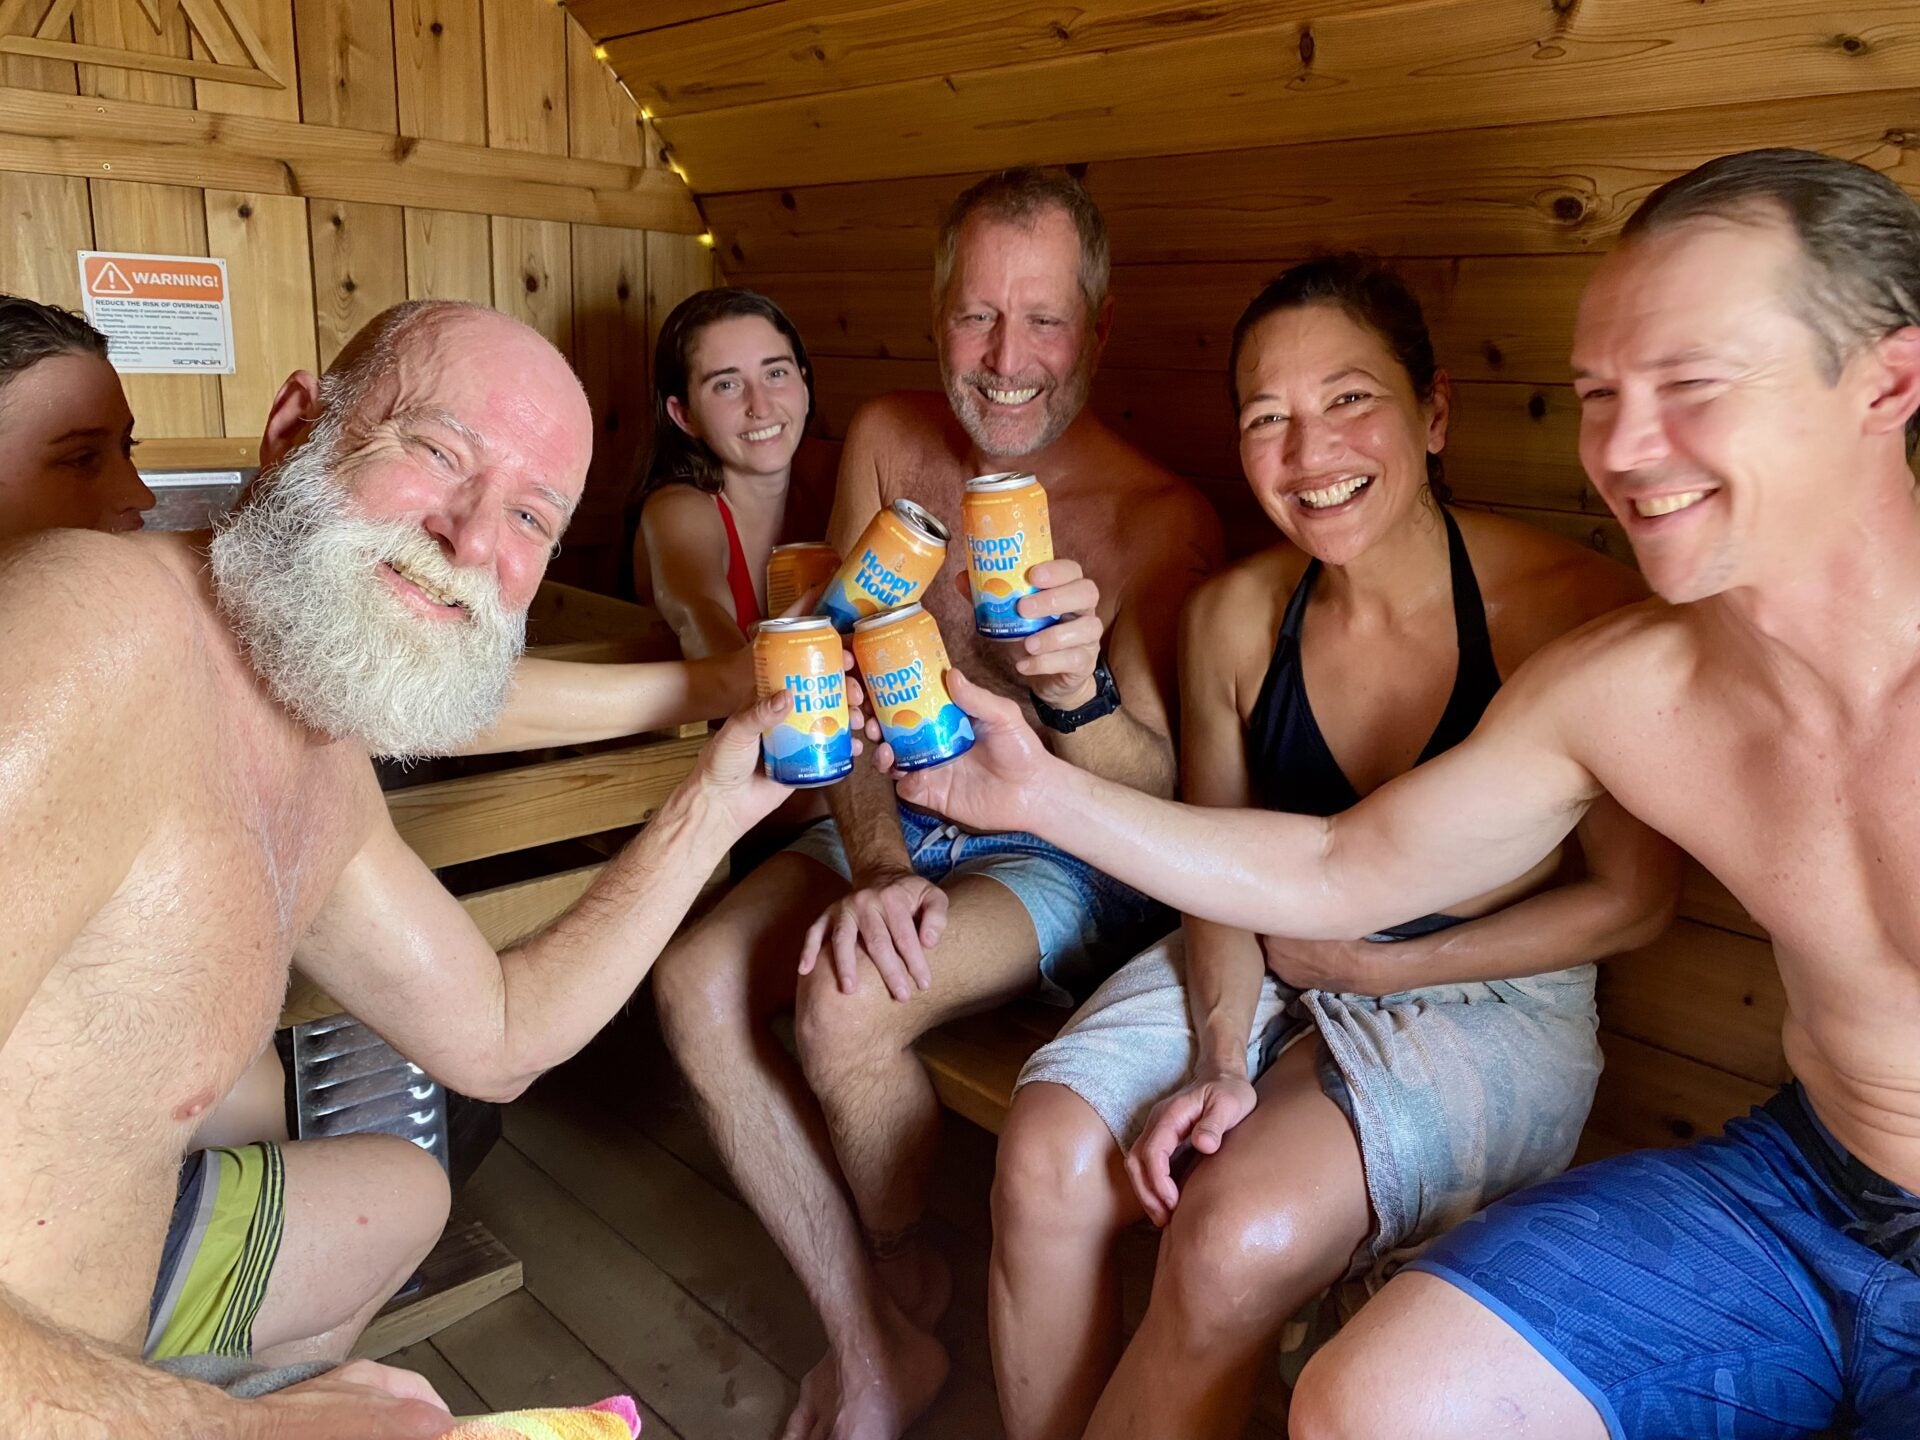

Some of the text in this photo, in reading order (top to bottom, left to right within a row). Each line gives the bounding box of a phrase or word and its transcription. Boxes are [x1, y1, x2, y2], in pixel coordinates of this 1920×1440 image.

[131, 271, 219, 288] WARNING!
[172, 302, 220, 310] OVERHEATING
[966, 531, 1024, 554] Hoppy
[860, 548, 918, 595] Hoppy
[973, 554, 1019, 572] Hour
[854, 568, 902, 608] Hour
[784, 668, 844, 693] Hoppy
[865, 659, 923, 688] Hoppy
[795, 692, 842, 713] Hour
[875, 684, 922, 708] Hour
